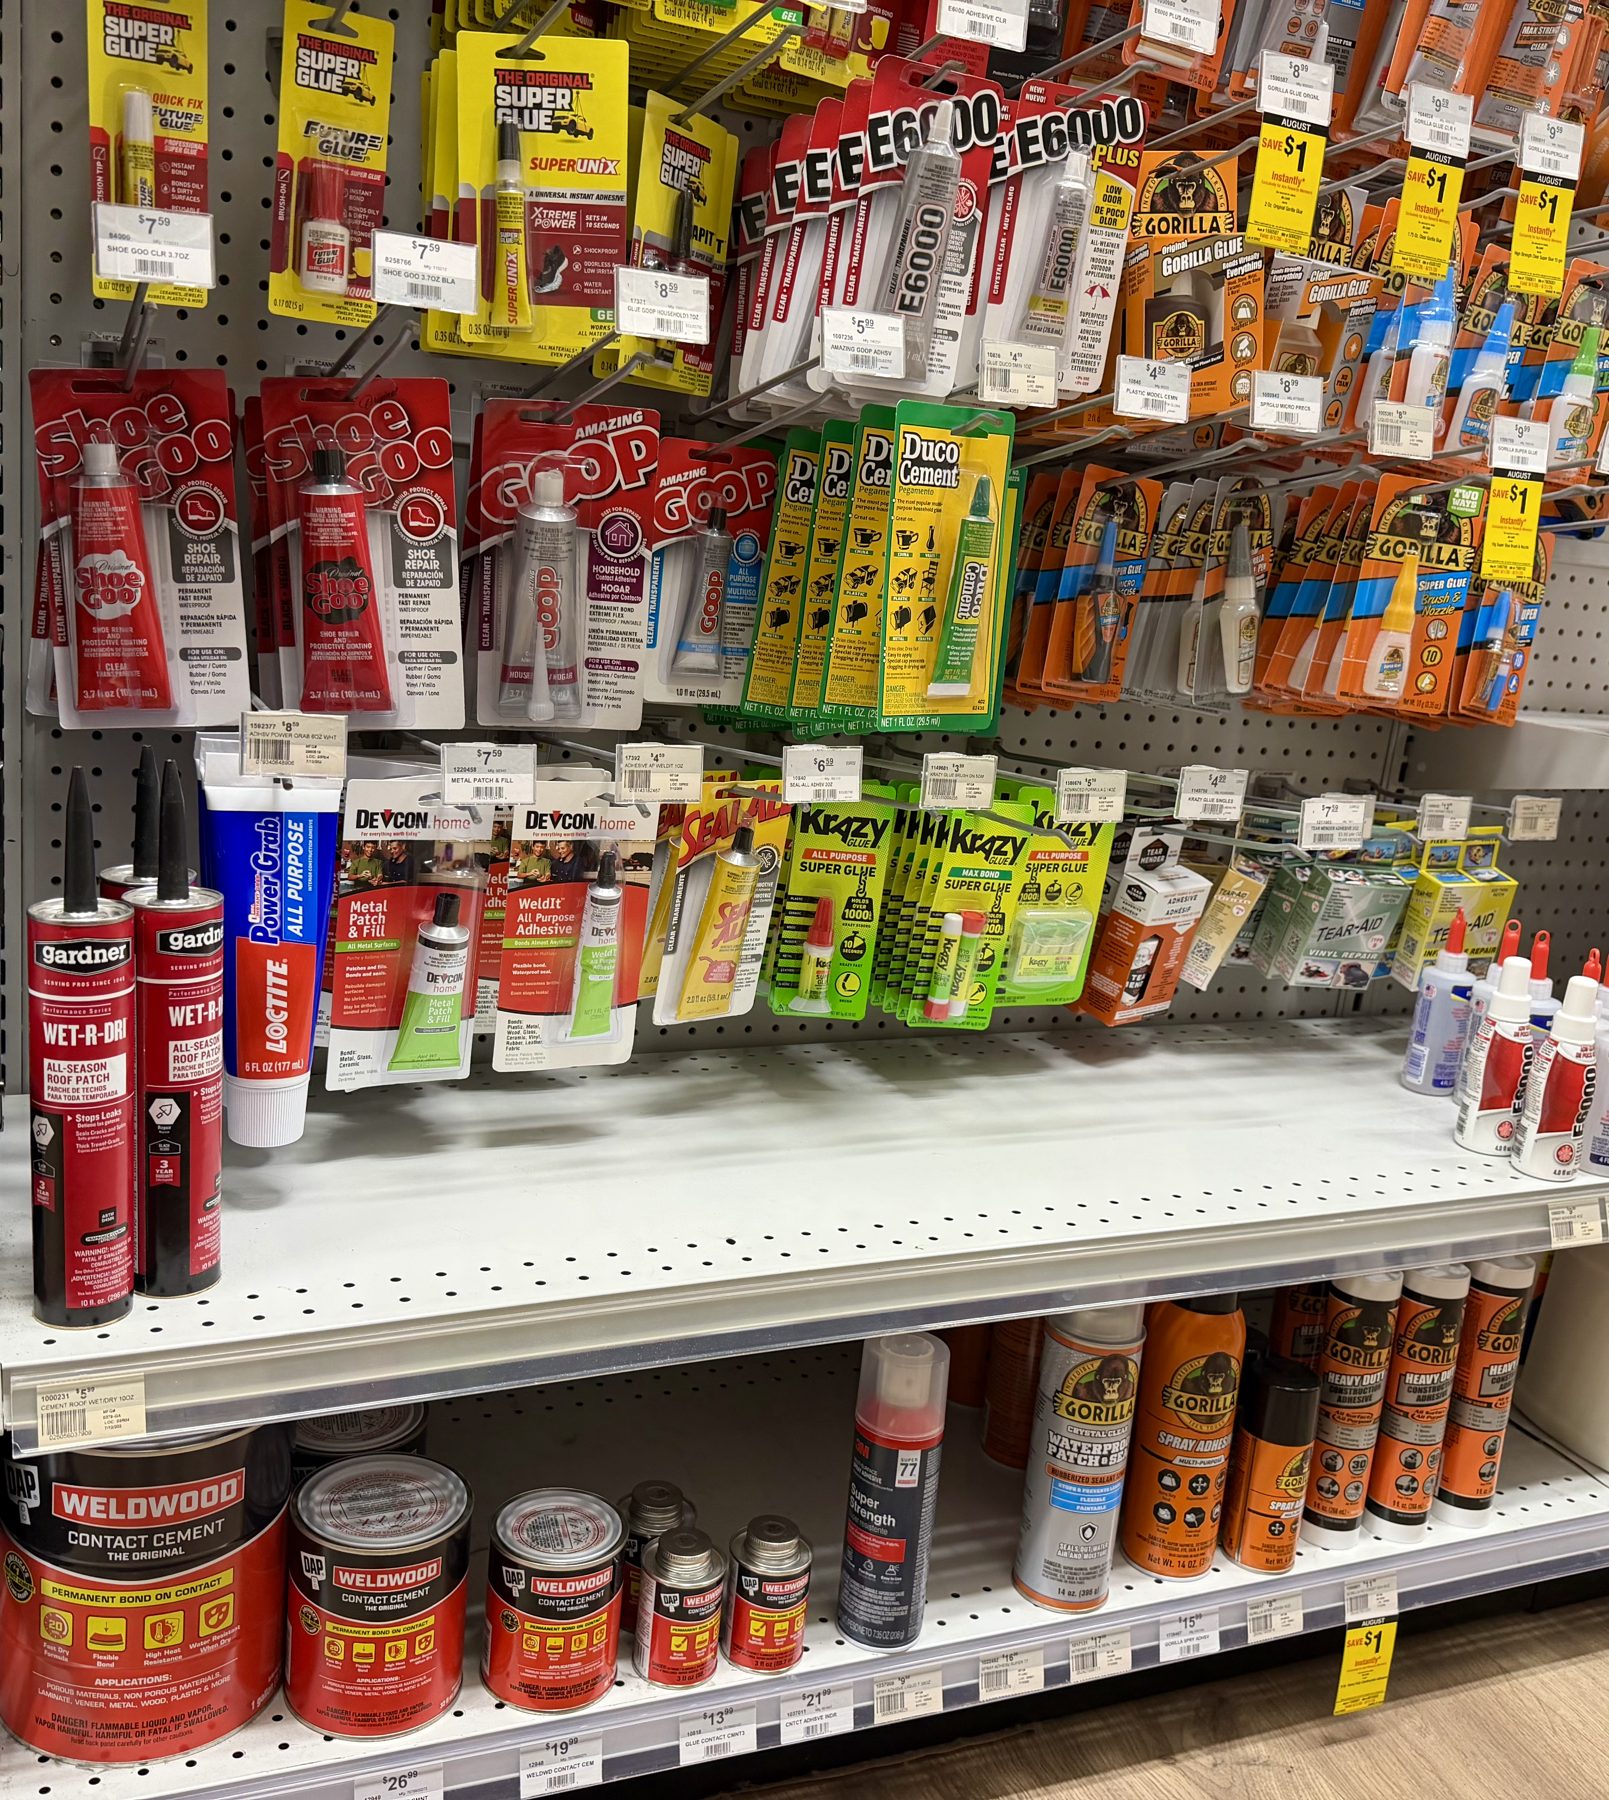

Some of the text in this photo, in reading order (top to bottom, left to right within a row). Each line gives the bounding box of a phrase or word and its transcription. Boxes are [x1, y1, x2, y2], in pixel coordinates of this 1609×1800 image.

[105, 3, 189, 28] THE ORIGINAL
[105, 16, 174, 46] SUPER
[105, 35, 157, 62] GLUE
[299, 35, 377, 63] THE ORIGINAL
[298, 48, 359, 78] SUPER
[297, 66, 343, 93] GLUE
[495, 70, 591, 89] THE ORIGINAL
[152, 93, 204, 109] QUICK FIX
[496, 85, 571, 109] SUPER
[159, 118, 192, 130] GLUE
[1016, 98, 1143, 165] E6000
[1281, 118, 1311, 132] AUGUST
[319, 140, 365, 159] GLUE
[1262, 135, 1307, 172] SAVE $1
[1092, 144, 1139, 171] PLUS
[1425, 152, 1452, 164] AUGUST
[1407, 167, 1447, 203] SAVE $1
[1537, 175, 1562, 186] AUGUST
[537, 191, 567, 199] UNIVERSAL
[595, 194, 625, 202] ADHESIVE
[1106, 185, 1122, 195] LOW
[1102, 193, 1122, 204] ODOR
[1095, 206, 1125, 218] DE POCO
[1520, 190, 1558, 224] SAVE $1
[1099, 215, 1118, 226] OLOR
[1145, 215, 1222, 235] GORILLA
[107, 245, 129, 253] SHOE
[1162, 240, 1188, 254] Original
[894, 204, 947, 317] E6000
[1162, 237, 1243, 276] GORILLA GLUE
[382, 269, 402, 278] SHOE
[403, 271, 420, 280] GOO
[442, 276, 456, 284] BLA
[831, 344, 855, 353] AMAZING
[856, 346, 873, 354] GOOP
[575, 411, 644, 440] AMAZING
[902, 434, 959, 463] Duco
[659, 467, 707, 488] AMAZING
[899, 463, 958, 488] Cement
[1507, 471, 1531, 480] AUGUST
[654, 462, 777, 533] GOOP
[898, 486, 934, 496] Pegamento
[1454, 488, 1479, 500] TWO
[1452, 498, 1477, 509] WAYS
[1492, 484, 1528, 514] SAVE $1
[187, 543, 217, 554] SHOE
[184, 553, 221, 565] REPAIR
[181, 565, 225, 575] REPARACIÓN
[592, 564, 641, 577] HOUSEHOLD
[738, 567, 749, 576] ALL
[185, 574, 223, 583] DE ZAPATO
[729, 574, 757, 584] PURPOSE
[1418, 578, 1467, 591] SUPER GLUE
[601, 583, 631, 594] HOGAR
[1420, 605, 1455, 616] Nozzle
[356, 809, 471, 830] DEVCON home
[526, 810, 636, 831] DEVCON home
[830, 853, 868, 862] PURPOSE
[1146, 847, 1164, 857] TEAR
[800, 863, 877, 877] SUPER GLUE
[962, 869, 1000, 879] MAX BOND
[251, 817, 281, 944] Power Grab
[287, 821, 304, 937] ALL PURPOSE
[944, 880, 1012, 893] SUPER GLUE
[350, 900, 388, 913] Metal
[1167, 895, 1197, 905] ADHESIVE
[349, 913, 386, 926] Patch
[517, 912, 575, 925] All Purpose
[348, 925, 385, 938] & Fill
[516, 923, 573, 935] Adhesive
[1317, 917, 1383, 942] TEAR-AID
[42, 944, 127, 964] gardner
[1308, 949, 1339, 957] VINYL
[265, 959, 288, 1054] LOCTITE
[43, 1017, 127, 1046] WET-R-DRI
[47, 1062, 107, 1073] ALL-SEASON
[245, 1062, 250, 1072] 6
[251, 1062, 261, 1072] FL
[263, 1061, 273, 1072] OZ
[274, 1060, 291, 1073] (177
[47, 1073, 110, 1085] ROOF PATCH
[1328, 1372, 1385, 1386] HEAVY DUTY
[41, 1403, 67, 1411] CEMENT
[88, 1396, 117, 1406] WET/DRY
[42, 1393, 69, 1402] 1000231
[1174, 1392, 1237, 1413] GORILLA
[1064, 1401, 1134, 1424] GORILLA
[1157, 1431, 1196, 1453] SPRAY
[1178, 1457, 1225, 1466] MULTI-PURPOSE
[900, 1462, 917, 1478] 77
[7, 1468, 37, 1500] DAP
[61, 1481, 238, 1520] WELDWOOD
[68, 1519, 225, 1549] CONTACT CEMENT
[107, 1546, 185, 1561] THE ORIGINAL
[304, 1554, 323, 1576] DAP
[338, 1562, 438, 1588] WELDWOOD
[504, 1569, 524, 1586] DAP
[535, 1570, 611, 1593] WELDWOOD
[52, 1577, 223, 1603] PERMANENT BOND ON CONTACT
[341, 1586, 430, 1605] CONTACT CEMENT
[1361, 1618, 1385, 1627] AUGUST
[1347, 1637, 1364, 1648] SAVE
[94, 1673, 172, 1686] APPLICATIONS:
[51, 1712, 88, 1731] DANGER!
[701, 1734, 726, 1744] CONTACT
[526, 1770, 553, 1779] WELDWD
[554, 1763, 580, 1773] CONTACT
